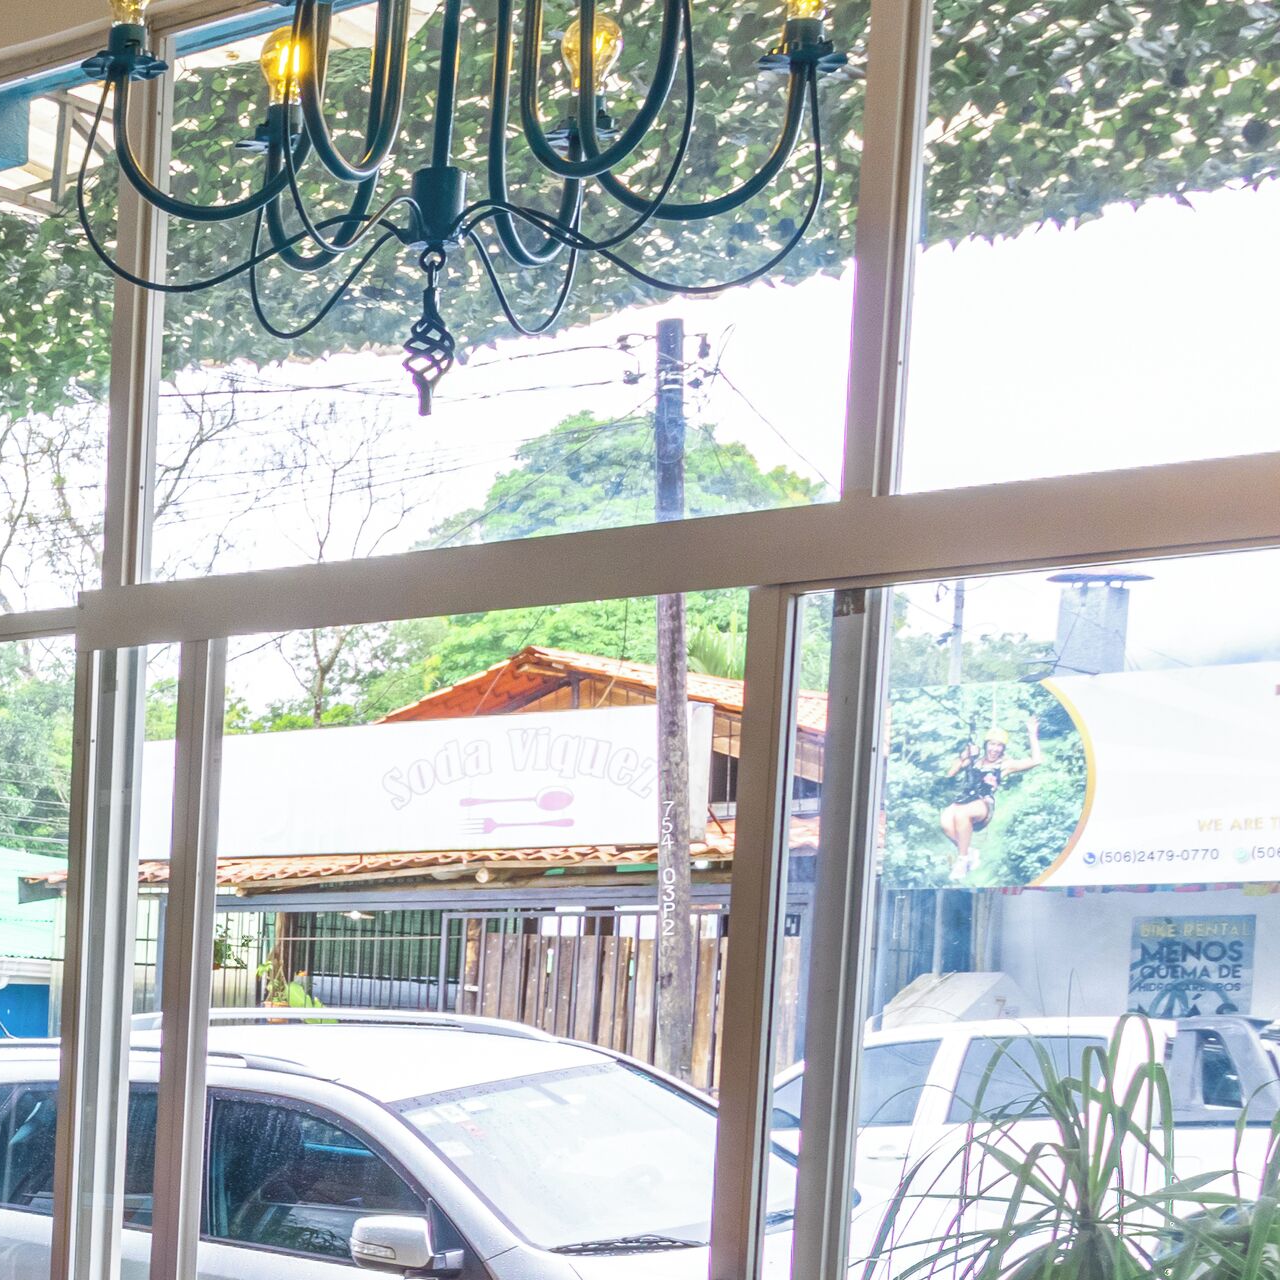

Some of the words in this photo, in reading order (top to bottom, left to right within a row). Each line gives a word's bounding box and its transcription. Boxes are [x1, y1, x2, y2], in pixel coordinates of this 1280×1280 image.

[382, 739, 492, 810] Soda
[506, 727, 657, 799] Viquez
[660, 801, 674, 849] 754
[1197, 818, 1223, 832] WE
[1230, 816, 1263, 831] ARE
[1099, 848, 1220, 863] (506)2479-0770
[1141, 922, 1176, 938] BIKE
[1183, 920, 1254, 937] RENTAL
[1139, 939, 1244, 963] MENOS
[1140, 963, 1210, 979] QUEMA
[1217, 963, 1242, 979] DE
